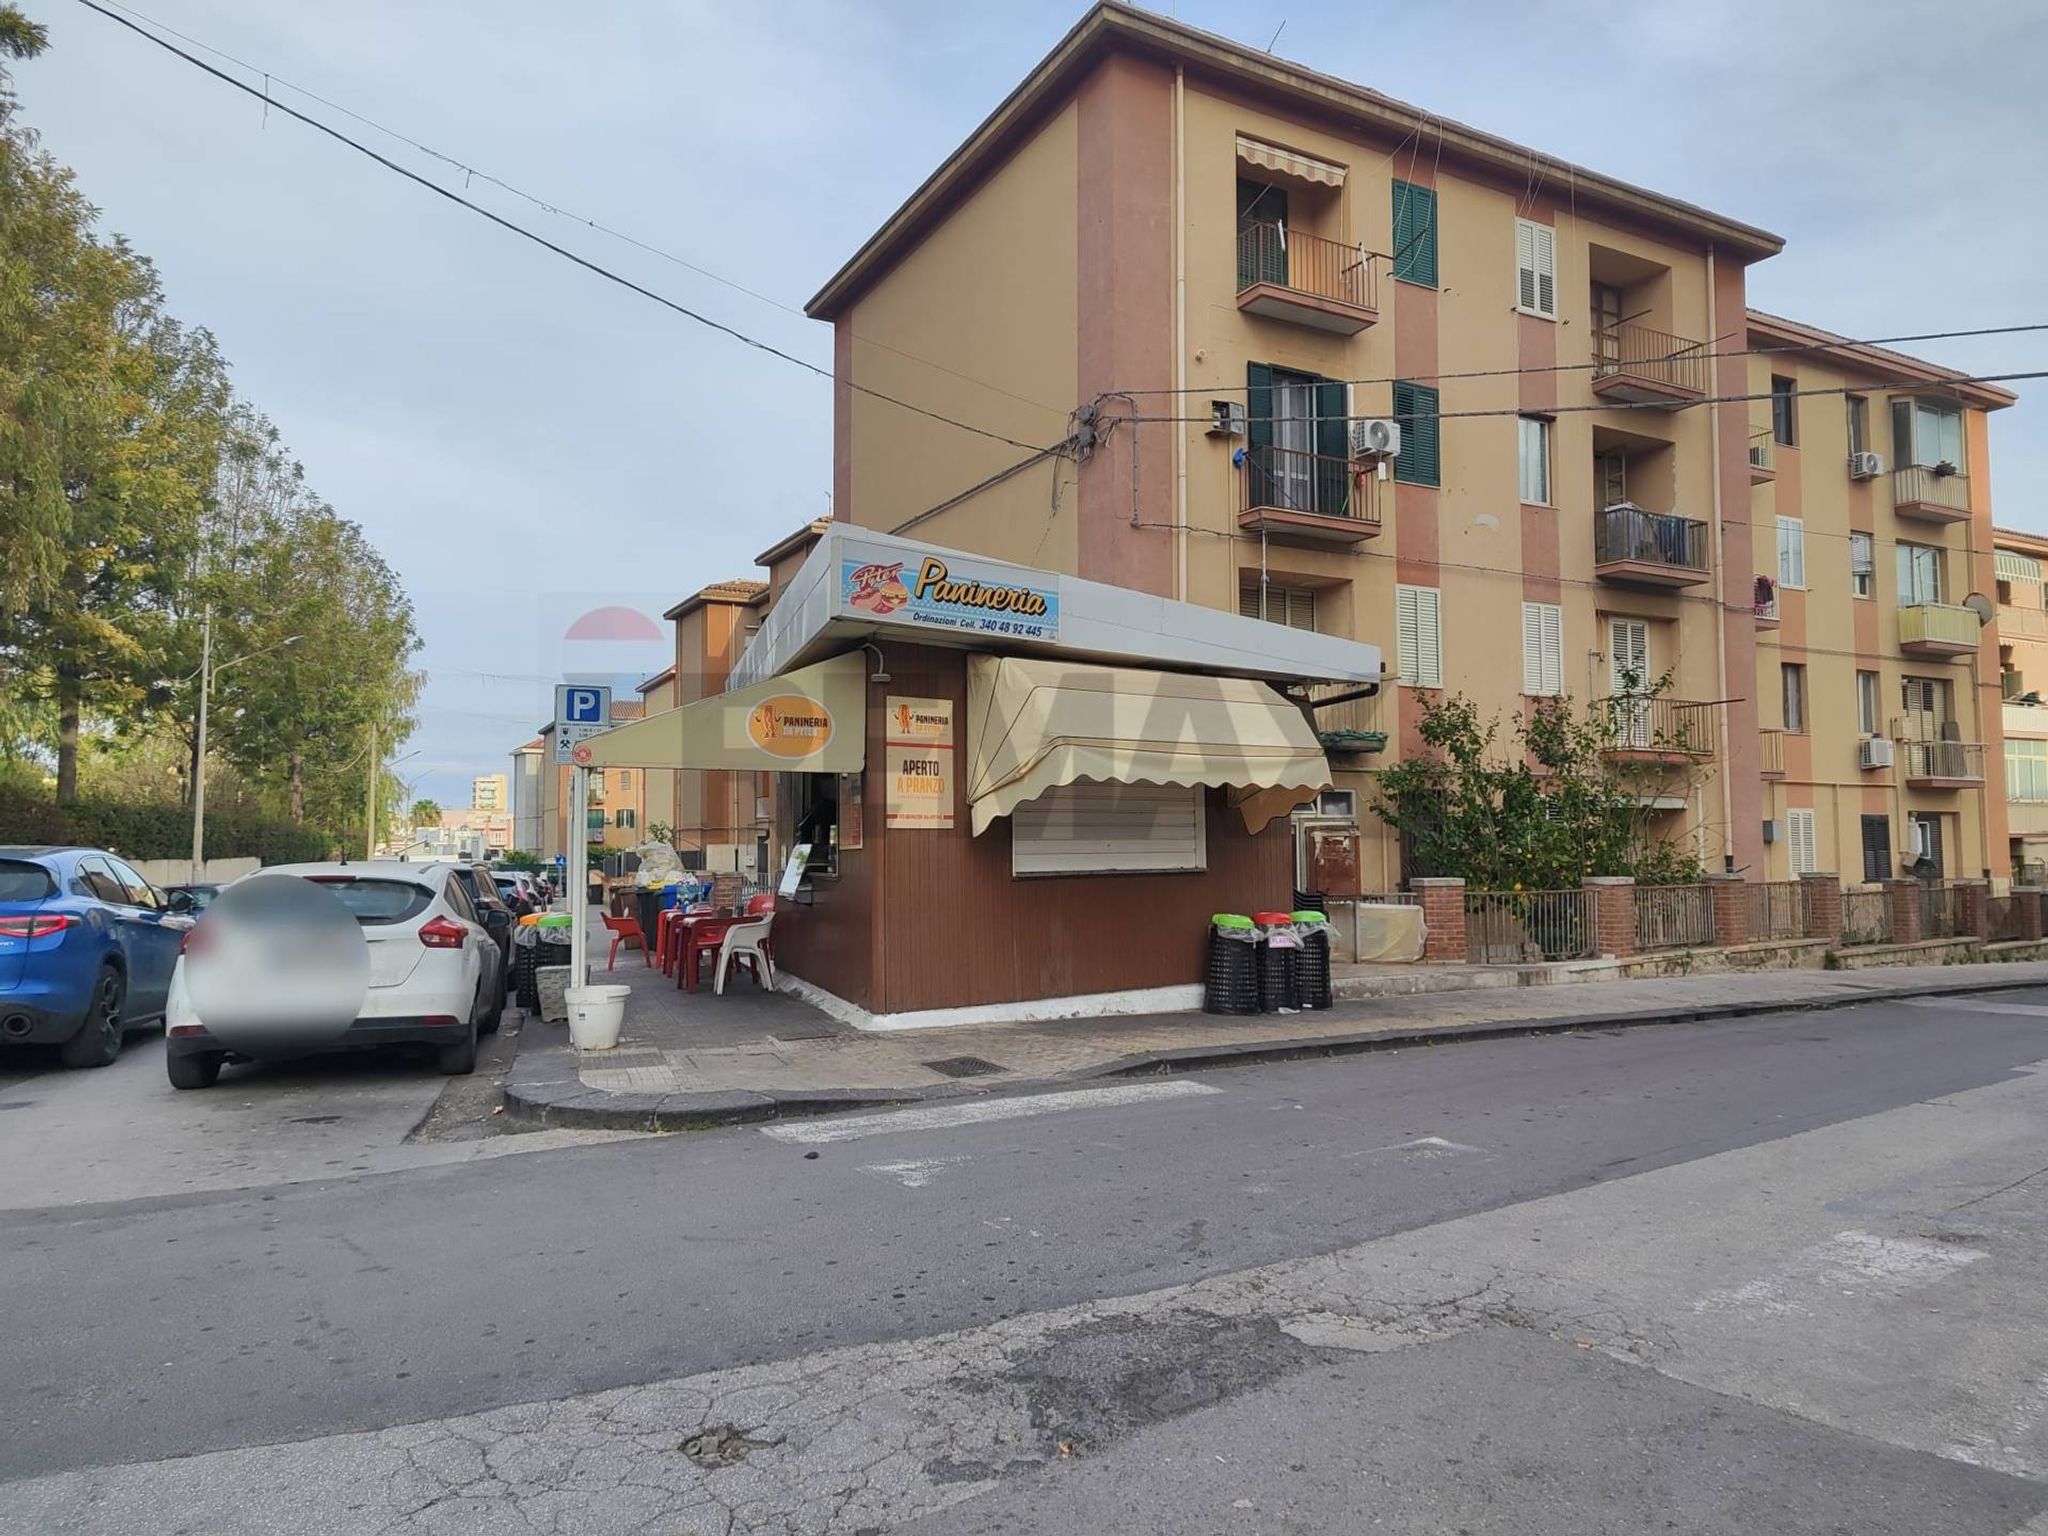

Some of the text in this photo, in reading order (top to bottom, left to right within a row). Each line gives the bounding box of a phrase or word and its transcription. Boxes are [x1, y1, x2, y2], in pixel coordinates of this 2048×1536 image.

[913, 556, 1047, 616] Panineria
[913, 612, 1042, 637] Ordinazioni Cell. 340 48 92 445
[573, 691, 596, 720] P
[783, 716, 828, 728] PANINERIA
[915, 714, 949, 726] PANINERIA
[902, 759, 939, 776] APERTO
[897, 777, 945, 794] A PRANZO
